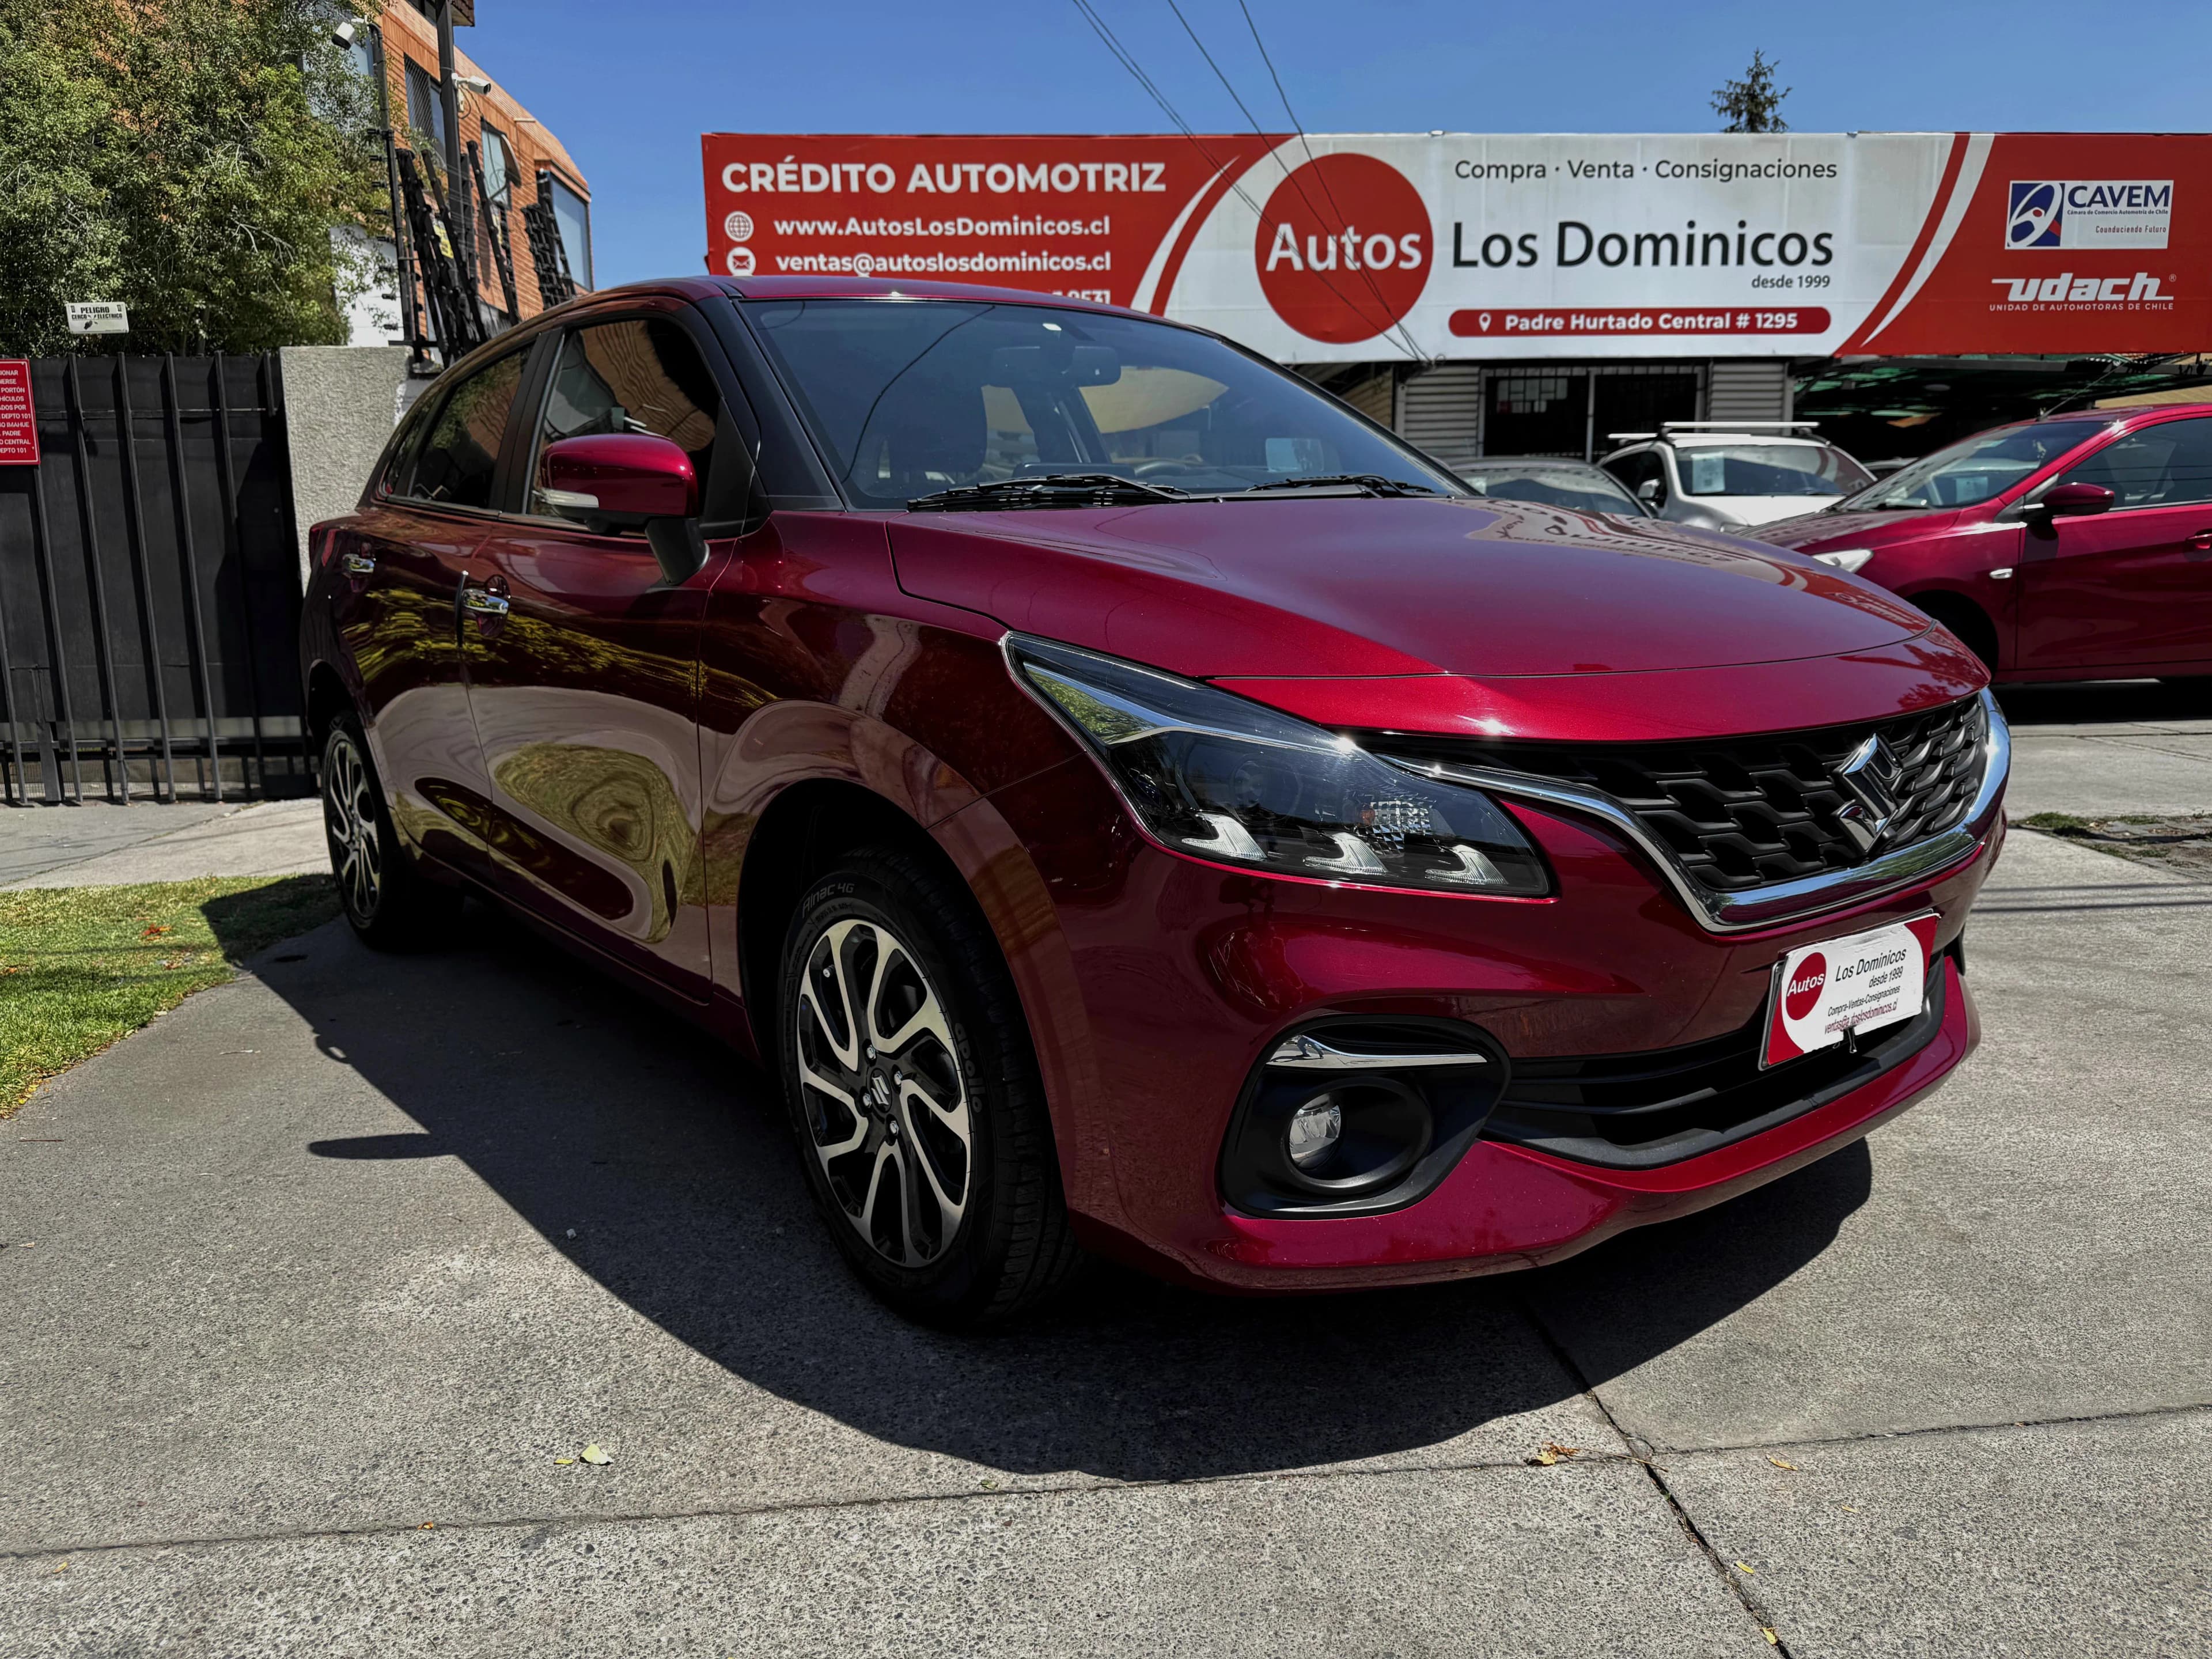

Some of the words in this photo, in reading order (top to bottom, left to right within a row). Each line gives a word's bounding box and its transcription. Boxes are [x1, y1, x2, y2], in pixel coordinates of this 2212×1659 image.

[722, 155, 895, 193] CRÉDITO
[907, 162, 1166, 193] AUTOMOTRIZ
[1455, 160, 1546, 183] Compra
[1567, 160, 1634, 179] Venta
[1656, 158, 1838, 183] Consignaciones
[2068, 185, 2170, 208] CAVEM
[774, 215, 1110, 237] www.AutosLosDominicos.cl
[2145, 225, 2166, 233] Futuro
[1266, 222, 1422, 271] Autos
[1453, 222, 1538, 268] Los
[1557, 220, 1833, 267] Dominicos
[776, 251, 1111, 276] ventas@autoslosdominicos.cl
[1751, 275, 1793, 288] desde
[1797, 275, 1830, 288] 1999
[1991, 272, 2174, 301] udach
[2050, 303, 2123, 311] AUTOMOTORAS
[1505, 314, 1563, 331] Padre
[1571, 313, 1653, 330] Hurtado
[1658, 313, 1730, 329] Central
[1736, 313, 1751, 328] #
[1755, 313, 1798, 329] 1295
[838, 882, 855, 893] 4G
[1835, 965, 1854, 982] Los
[1856, 948, 1907, 975] Dominicos
[1869, 971, 1888, 988] desde
[1888, 965, 1904, 982] 1999
[1786, 973, 1825, 997] Autos
[955, 1022, 983, 1113] apollo
